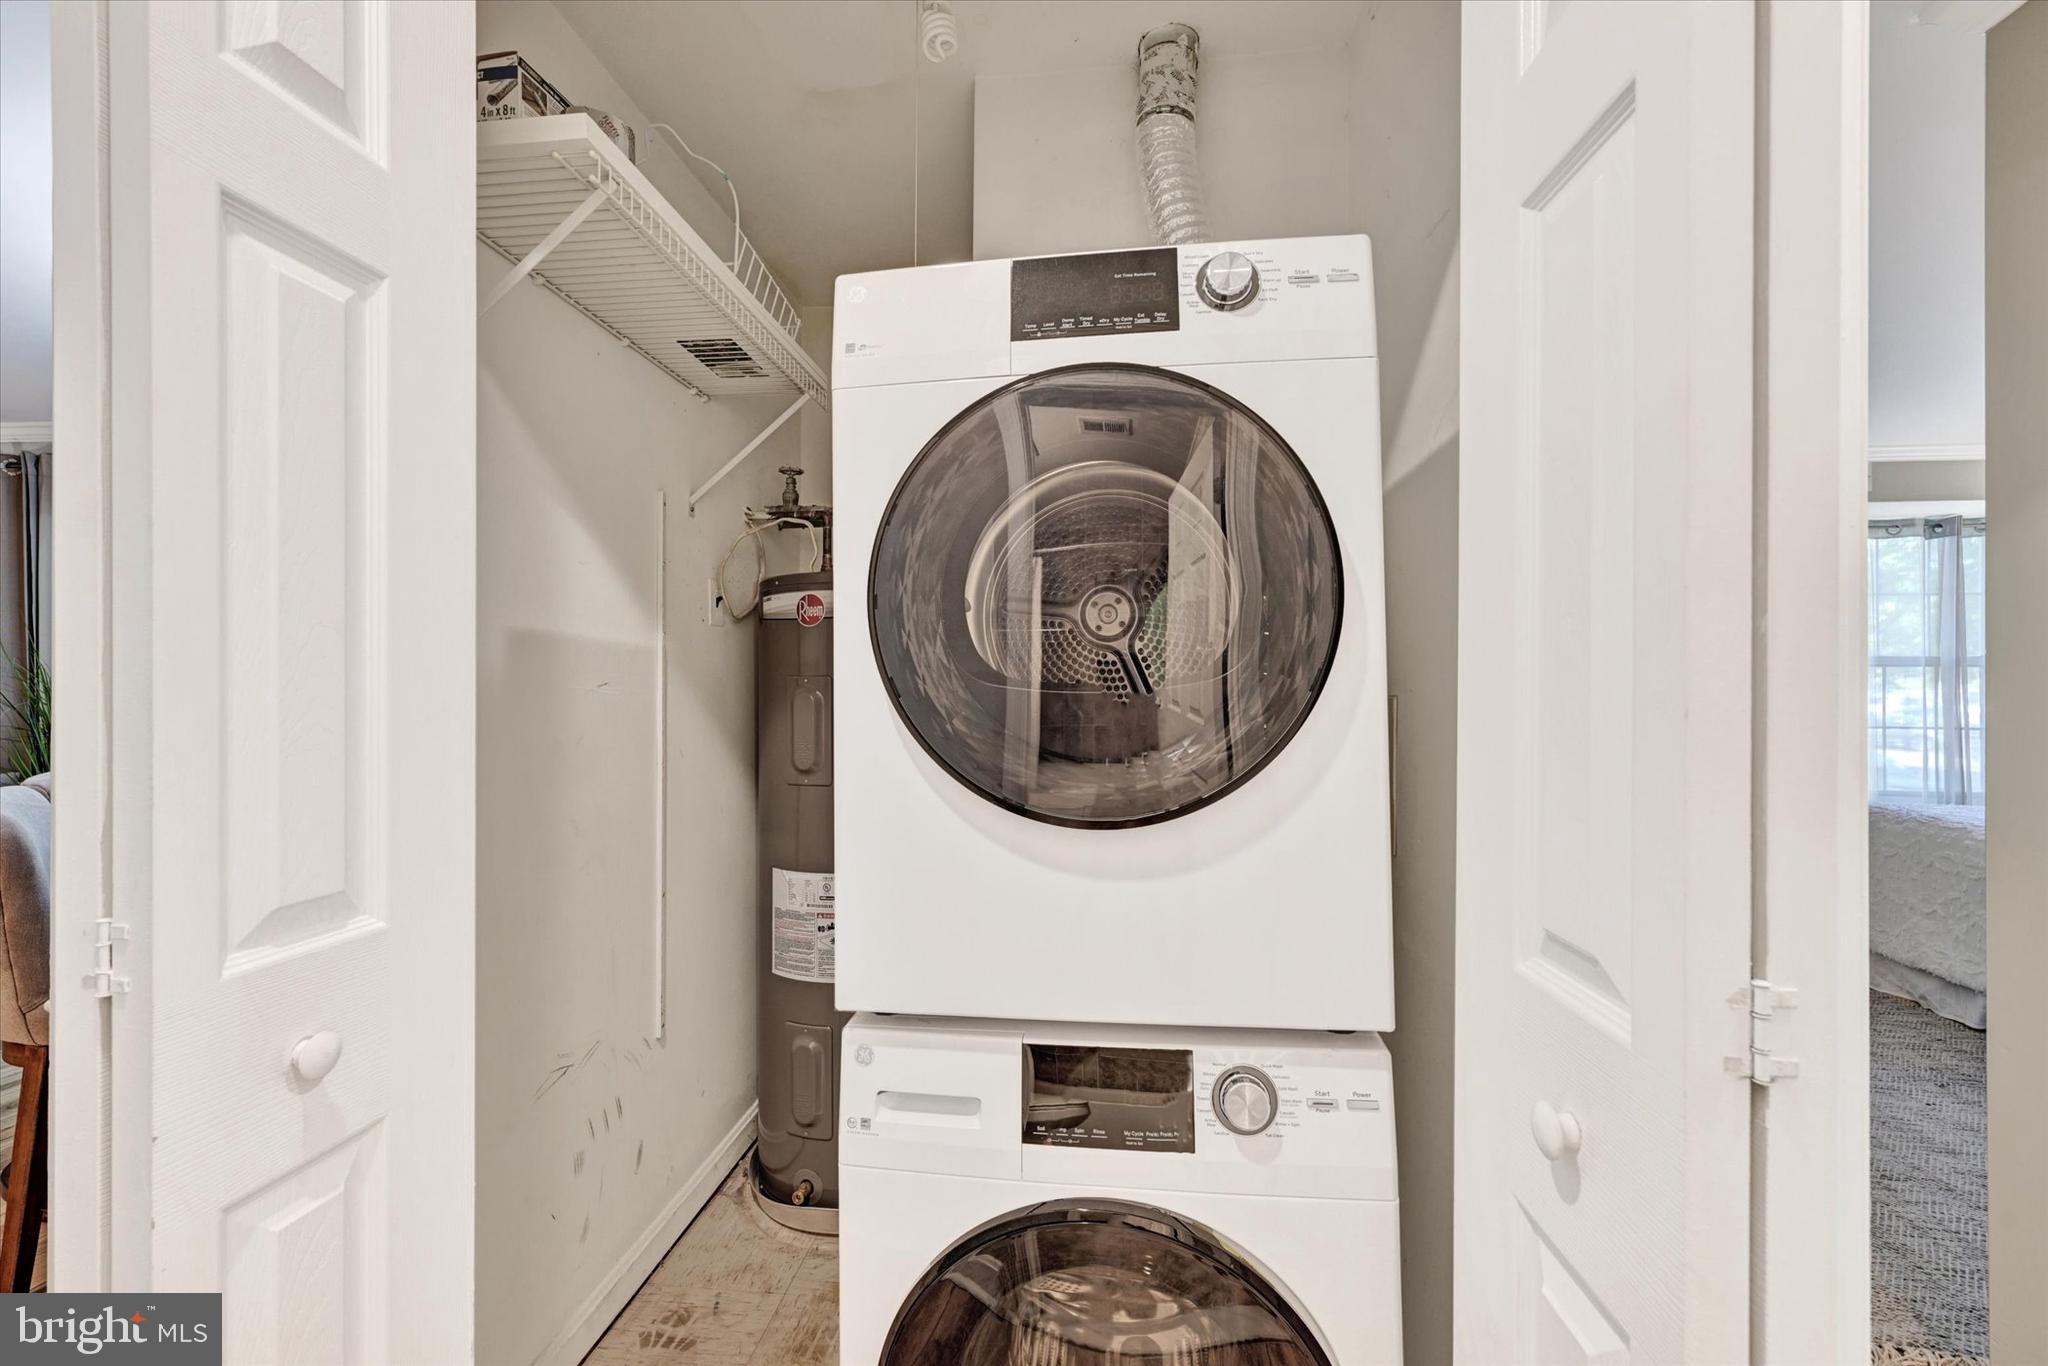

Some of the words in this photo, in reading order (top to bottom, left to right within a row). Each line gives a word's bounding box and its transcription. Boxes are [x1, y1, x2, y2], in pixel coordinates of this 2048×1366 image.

[480, 106, 486, 118] 4
[503, 104, 509, 116] 8
[799, 595, 824, 622] Rheem
[1352, 1090, 1371, 1098] Power
